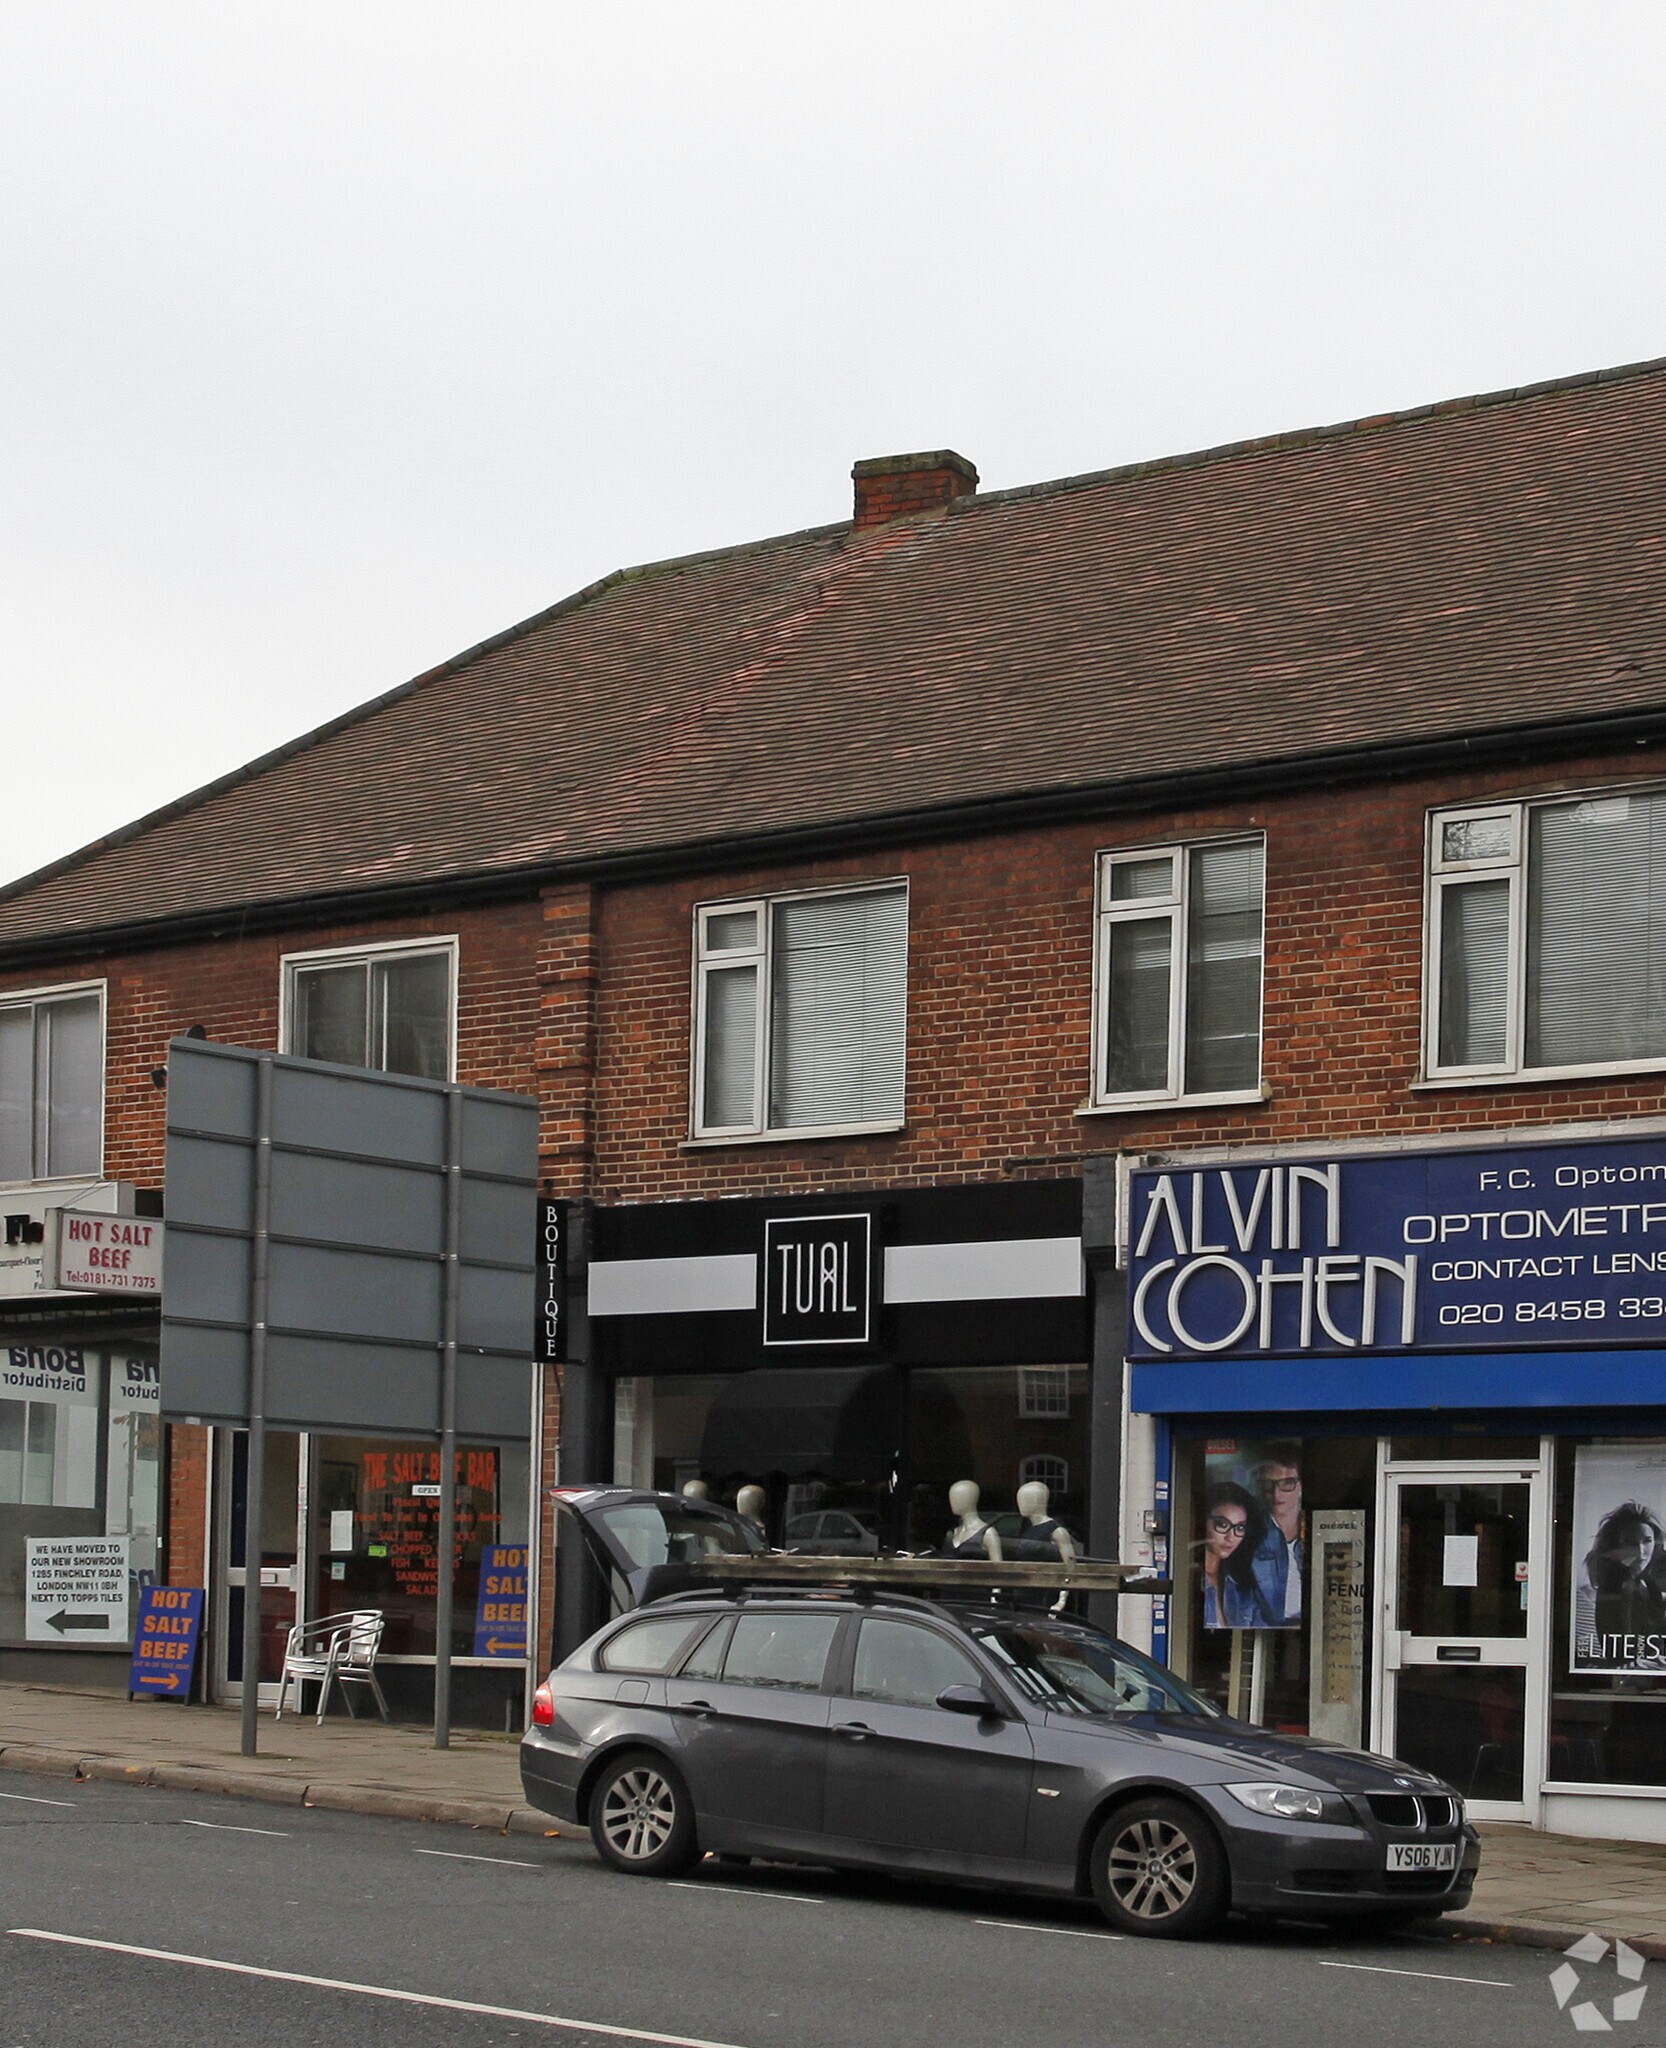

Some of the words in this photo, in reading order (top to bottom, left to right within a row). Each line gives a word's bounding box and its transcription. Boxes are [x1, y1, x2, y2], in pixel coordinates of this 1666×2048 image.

[1135, 1164, 1340, 1257] ALVIN
[69, 1219, 103, 1242] HOT
[110, 1223, 152, 1246] SALT
[89, 1247, 131, 1269] BEEF
[1432, 1255, 1584, 1282] CONTACT
[1593, 1252, 1666, 1274] LENS
[66, 1270, 128, 1286] Tel:0181-731
[132, 1276, 156, 1288] 7375
[544, 1206, 559, 1356] BOUTIQUE
[777, 1241, 857, 1315] TUAL
[1133, 1254, 1418, 1352] COHEN
[1439, 1303, 1504, 1325] 020
[1515, 1300, 1606, 1322] 8458
[1618, 1297, 1666, 1318] 33
[364, 1453, 387, 1492] THE
[392, 1453, 424, 1483] SALT
[429, 1453, 462, 1482] BF
[467, 1452, 495, 1492] BAR
[36, 1545, 48, 1554] WE
[51, 1545, 73, 1554] HAVE
[75, 1544, 106, 1554] MOVED
[108, 1544, 120, 1553] TO
[31, 1557, 50, 1566] OUR
[52, 1557, 71, 1566] NEW
[73, 1557, 124, 1566] SHOWROOM
[54, 1569, 96, 1578] FINCHLEY
[37, 1582, 74, 1590] LONDON
[486, 1576, 528, 1595] SAL
[31, 1594, 54, 1602] NEXT
[56, 1594, 69, 1602] TO
[71, 1594, 98, 1602] TOPPS
[100, 1594, 123, 1602] TILES
[151, 1590, 192, 1609] HOT
[143, 1615, 193, 1635] SALT
[140, 1640, 190, 1660] BEEF
[1589, 1633, 1635, 1659] LITE
[1395, 1847, 1431, 1866] YS06
